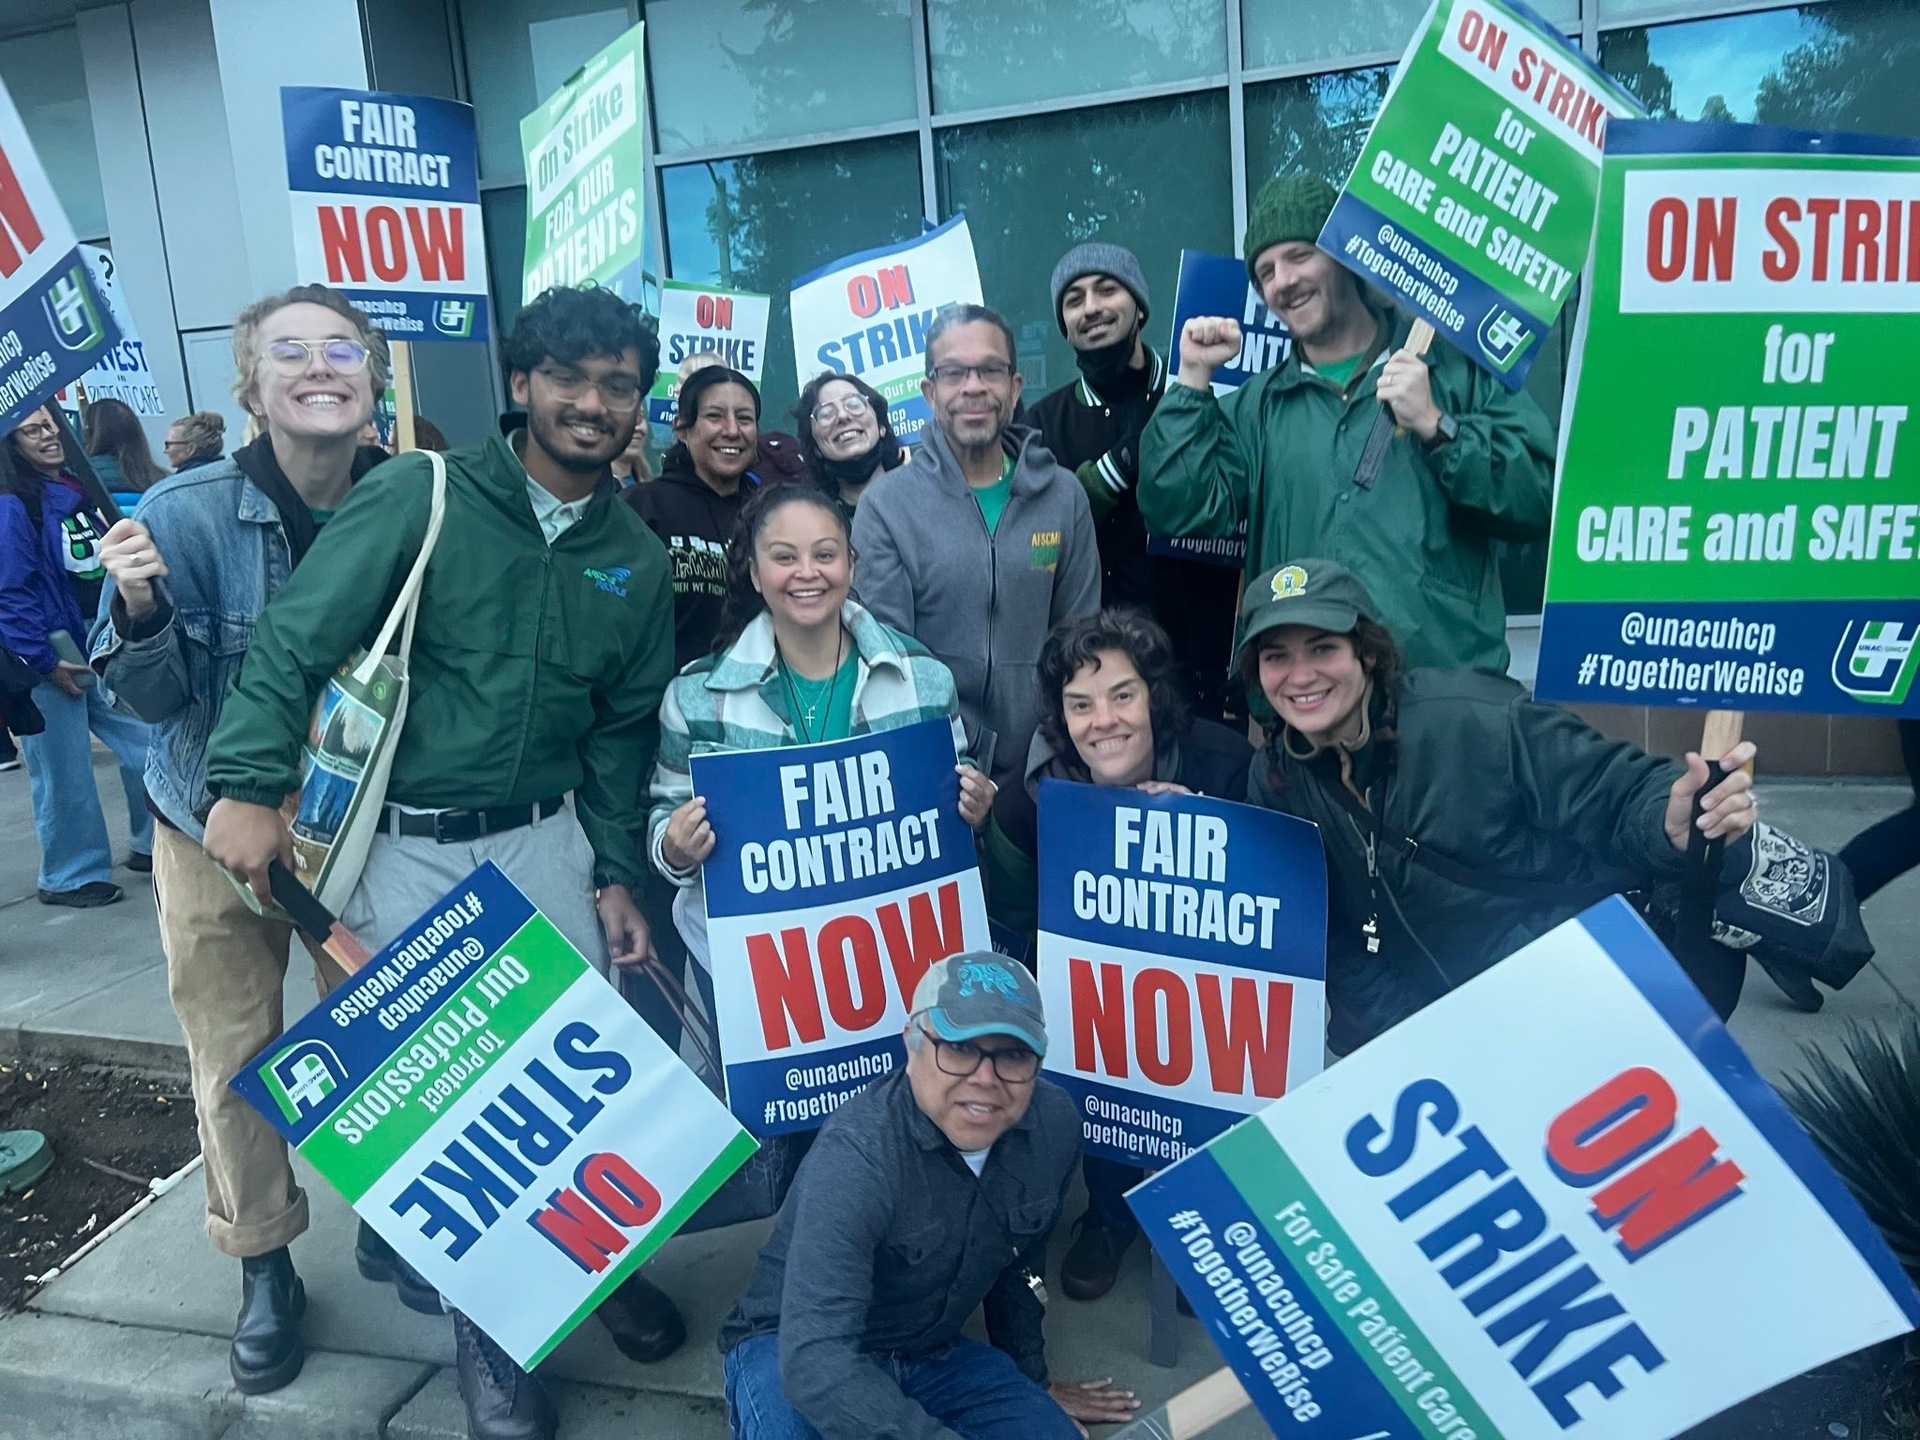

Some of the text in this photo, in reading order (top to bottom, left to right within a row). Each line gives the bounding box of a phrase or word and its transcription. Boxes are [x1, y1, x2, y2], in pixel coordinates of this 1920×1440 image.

[1457, 9, 1508, 73] ON
[340, 100, 417, 148] FAIR
[538, 147, 559, 193] On
[563, 81, 624, 165] Strike
[1494, 107, 1536, 156] for
[315, 145, 451, 188] CONTRACT
[545, 153, 614, 251] FOR OUR
[1429, 122, 1559, 232] PATIENT
[317, 205, 466, 284] NOW
[527, 187, 637, 301] PATIENTS
[1371, 150, 1572, 301] CARE and SAFETY
[1378, 224, 1459, 296] @unacuhcp
[1646, 196, 1920, 283] ON STRI
[350, 299, 407, 316] nacuhcp
[696, 295, 733, 331] ON
[847, 264, 917, 319] ON
[1344, 234, 1466, 333] #TogetherWeRise
[93, 341, 148, 372] NVEST
[668, 334, 755, 372] STRIKE
[1763, 323, 1835, 384] for
[1667, 405, 1909, 481] PATIENT
[1576, 504, 1920, 563] CARE and SAFE
[1621, 612, 1776, 655] @unacuhcp
[1578, 652, 1804, 696] #TogetherWeRise
[779, 749, 896, 830] FAIR
[739, 808, 942, 894] CONTRACT
[1114, 806, 1228, 882] FAIR
[1073, 870, 1280, 950] CONTRACT
[330, 891, 484, 1028] #TogetherWeRise
[378, 936, 485, 1031] @unacuhcp
[745, 881, 966, 1052] NOW
[333, 954, 530, 1146] Our Professions
[1068, 957, 1294, 1099] NOW
[417, 1029, 506, 1114] To Protect
[764, 1082, 872, 1124] #Together
[785, 1052, 893, 1091] @unacuhcp
[389, 1021, 632, 1262] STRIKE
[1083, 1121, 1196, 1161] ogetherWeRi
[1085, 1094, 1182, 1138] @unacuhcp
[1544, 1065, 1748, 1265] ON
[526, 1151, 662, 1276] ON
[1344, 1077, 1670, 1430] STRIKE
[1168, 1209, 1322, 1423] #TogetherWeRise
[1223, 1221, 1334, 1371] @unacuhcp
[1275, 1200, 1478, 1440] For Safe Patient Care
